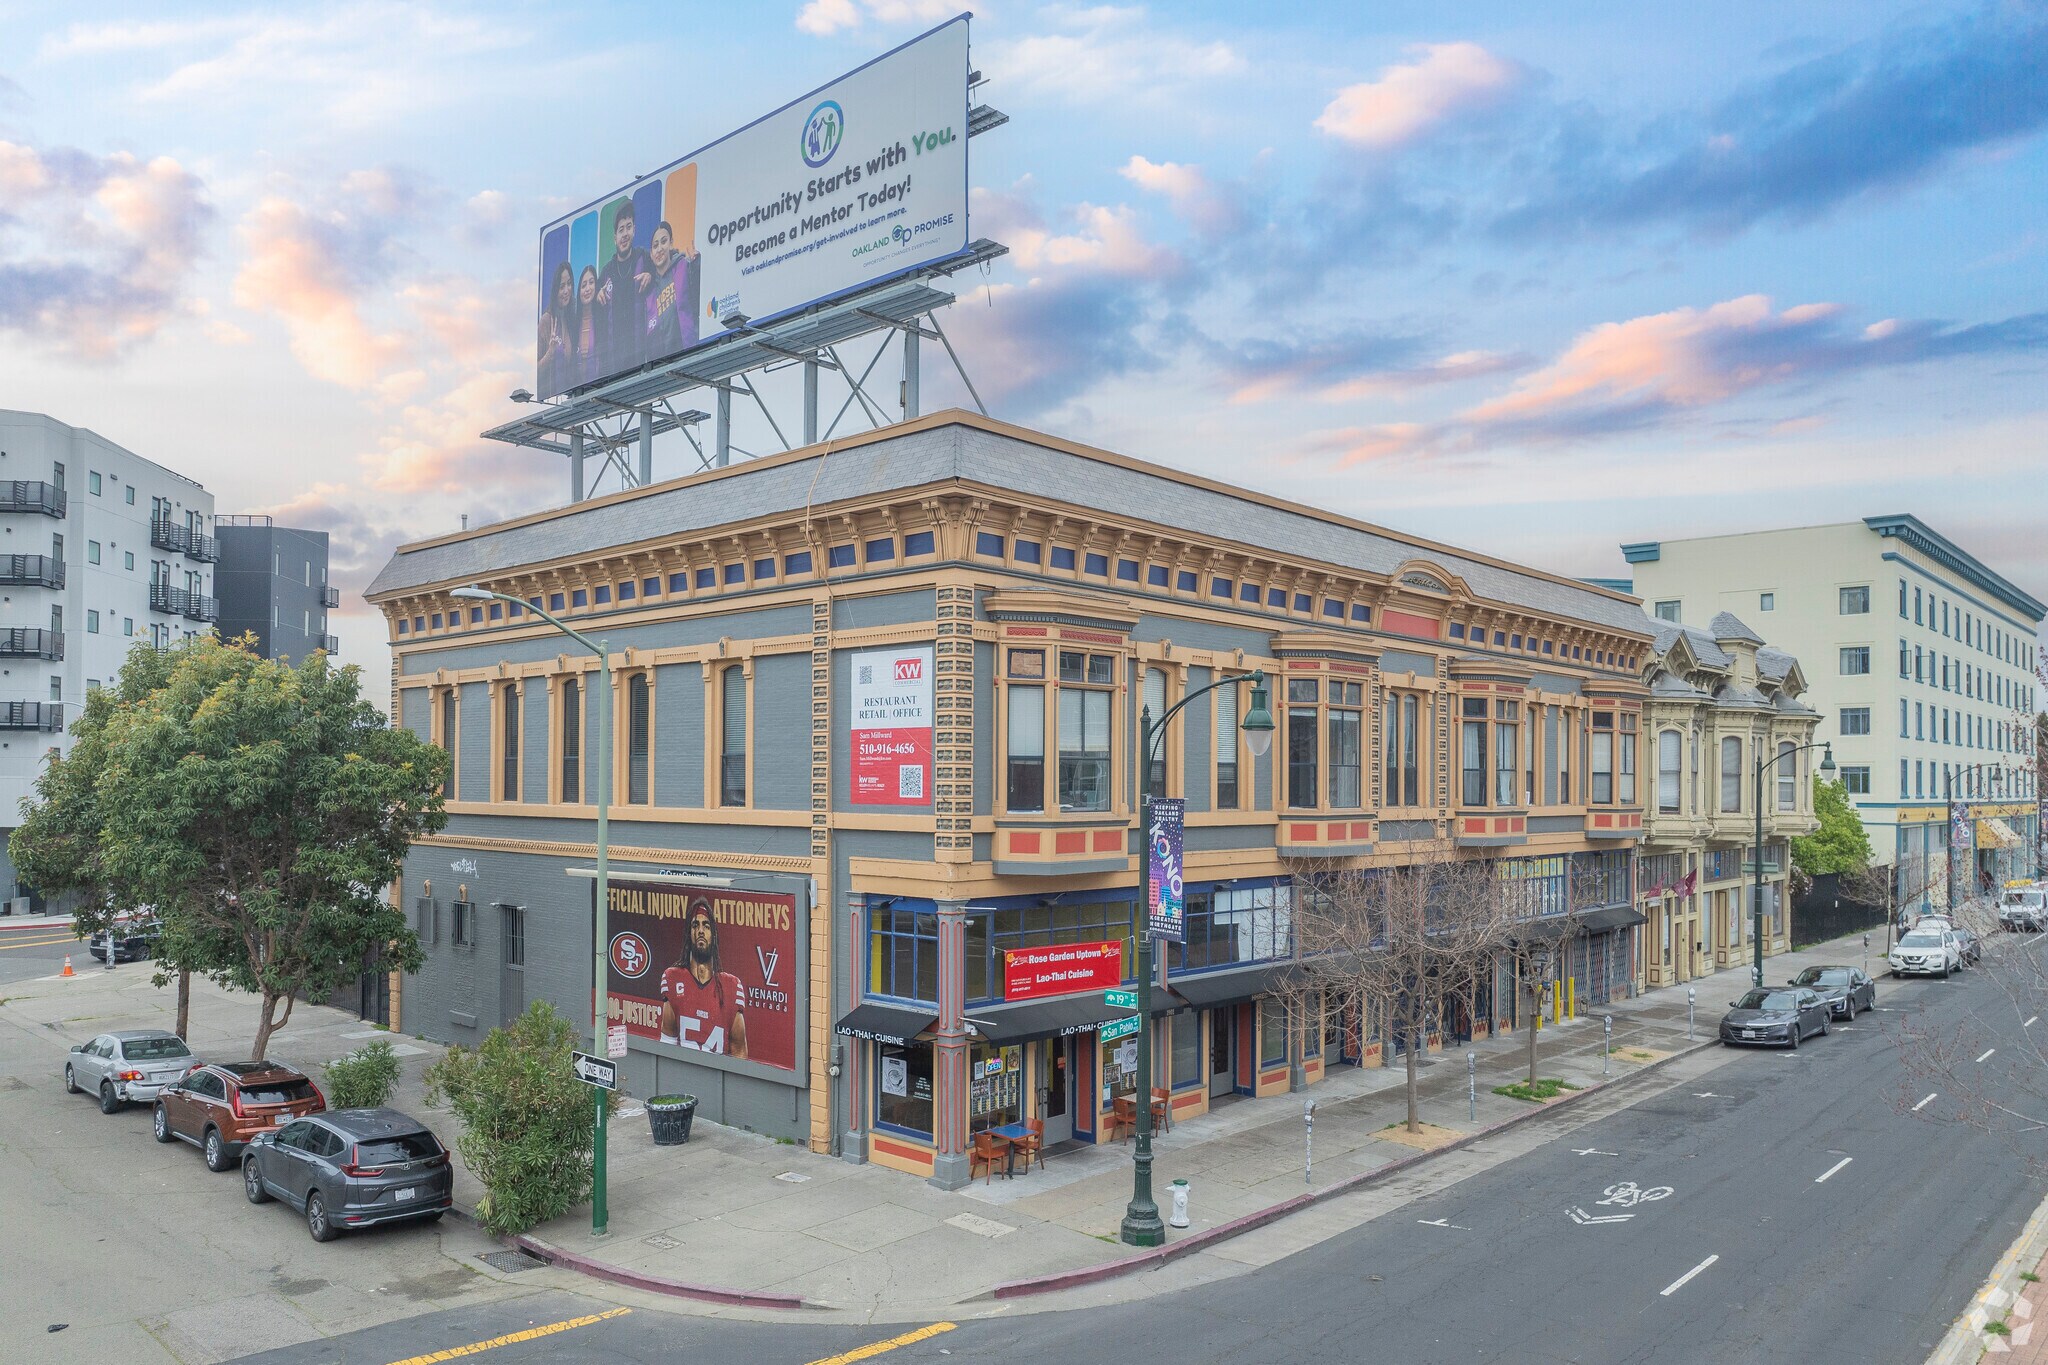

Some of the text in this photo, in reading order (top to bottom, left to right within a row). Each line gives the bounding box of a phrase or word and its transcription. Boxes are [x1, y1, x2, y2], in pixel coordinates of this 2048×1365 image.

[708, 126, 956, 245] Opportunity Starts with You.
[735, 174, 911, 262] Become a Mentor Today!
[914, 213, 954, 235] PROMISE
[741, 207, 907, 276] Visit oaklandpromise.org/get-involved to learn more.
[852, 236, 890, 258] OAKLAND
[863, 253, 891, 268] OPPORTUNITY
[891, 246, 911, 258] CHANGES
[895, 662, 921, 679] KW
[864, 695, 918, 707] RESTAURANT
[859, 708, 923, 719] RETAIL OFFICE
[859, 743, 915, 755] 510-916-4656
[1951, 811, 1970, 838] KONO
[1149, 822, 1183, 897] KONO
[607, 887, 790, 931] FICIAL INJURY ATTORNEYS
[620, 939, 643, 972] SF
[1028, 954, 1048, 965] Rose
[1049, 951, 1075, 963] Garden
[1076, 949, 1101, 961] Uptown
[1036, 970, 1066, 983] Lao-Thai
[1067, 968, 1094, 979] Cuisine
[748, 987, 788, 1004] VENARDI
[748, 999, 788, 1012] zurada
[837, 1025, 904, 1046] LAO THAI CUISINE
[1060, 1026, 1075, 1036] LAO
[1077, 1023, 1094, 1032] THAI
[1107, 1027, 1118, 1038] San
[1119, 1021, 1134, 1035] Pablo
[584, 1063, 612, 1080] ONE WAY
